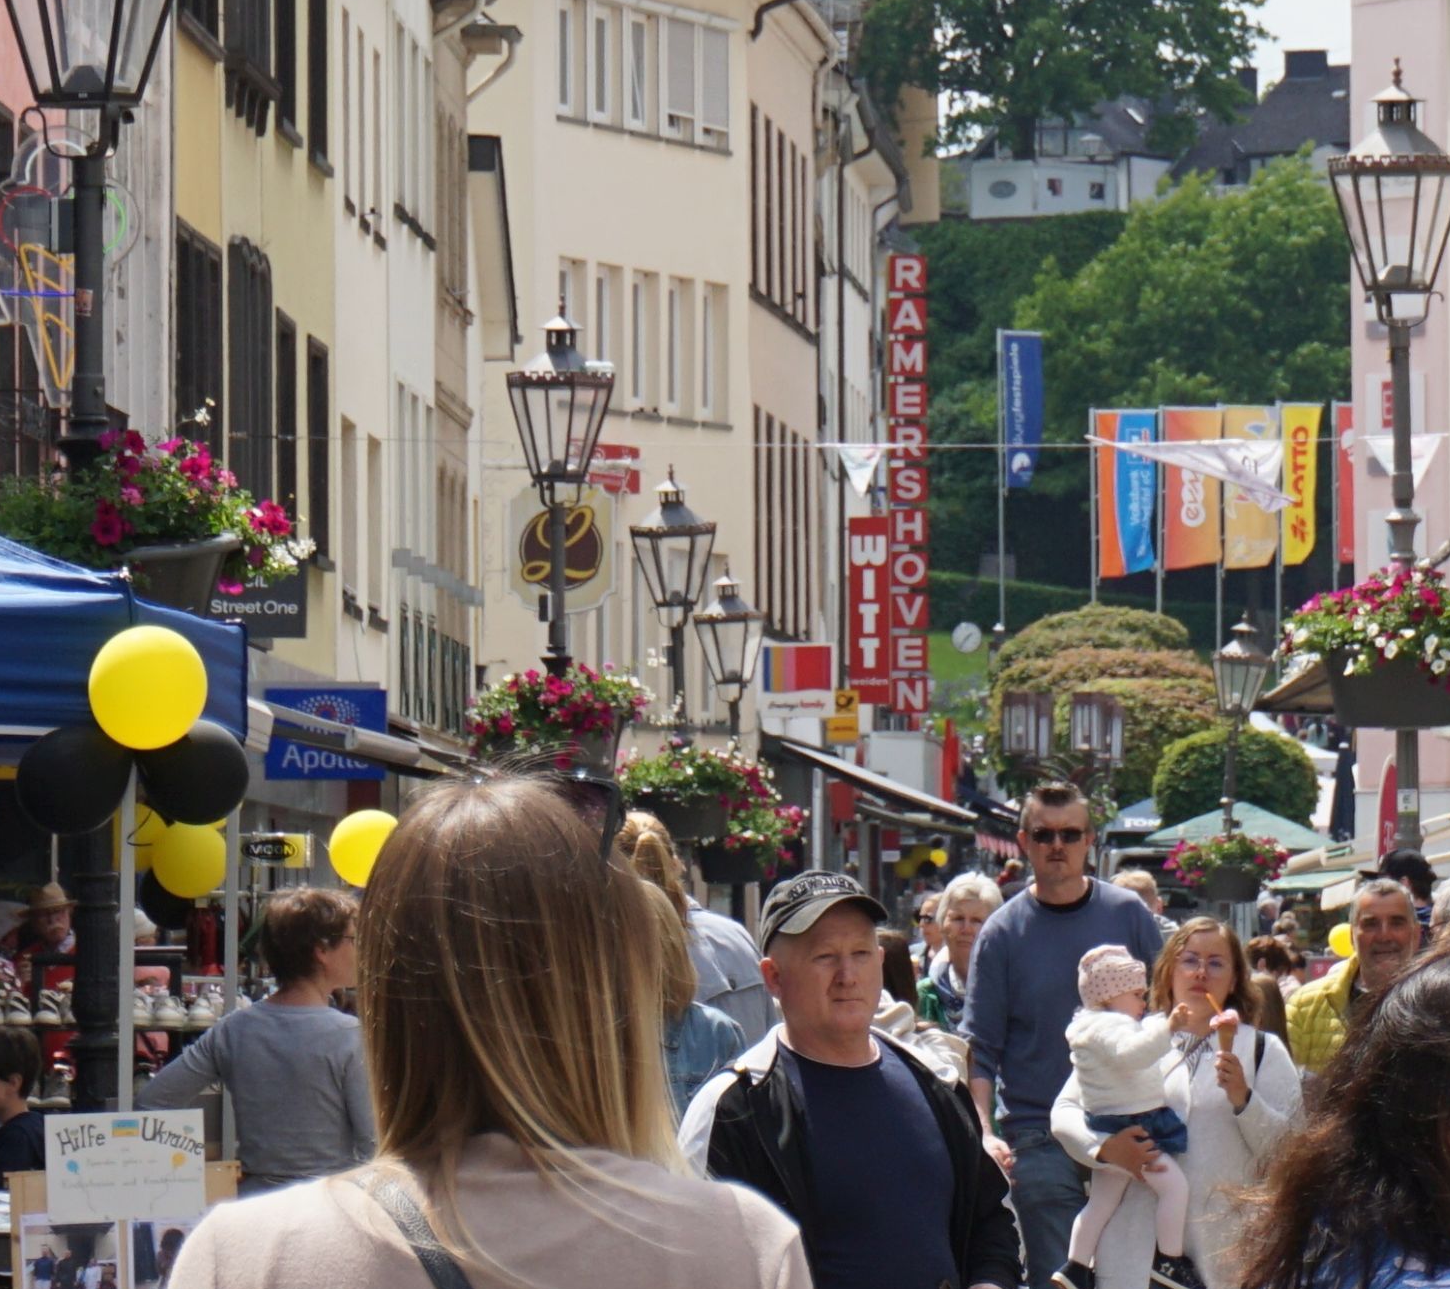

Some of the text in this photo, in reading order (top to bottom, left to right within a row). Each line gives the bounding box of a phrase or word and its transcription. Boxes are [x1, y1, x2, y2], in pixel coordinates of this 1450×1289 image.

[892, 257, 926, 710] RAMERSHOVEN
[1290, 426, 1310, 509] LOTTO
[210, 599, 298, 615] Street One
[850, 534, 888, 669] WITT
[55, 1116, 206, 1156] Hilfe Ukraine
